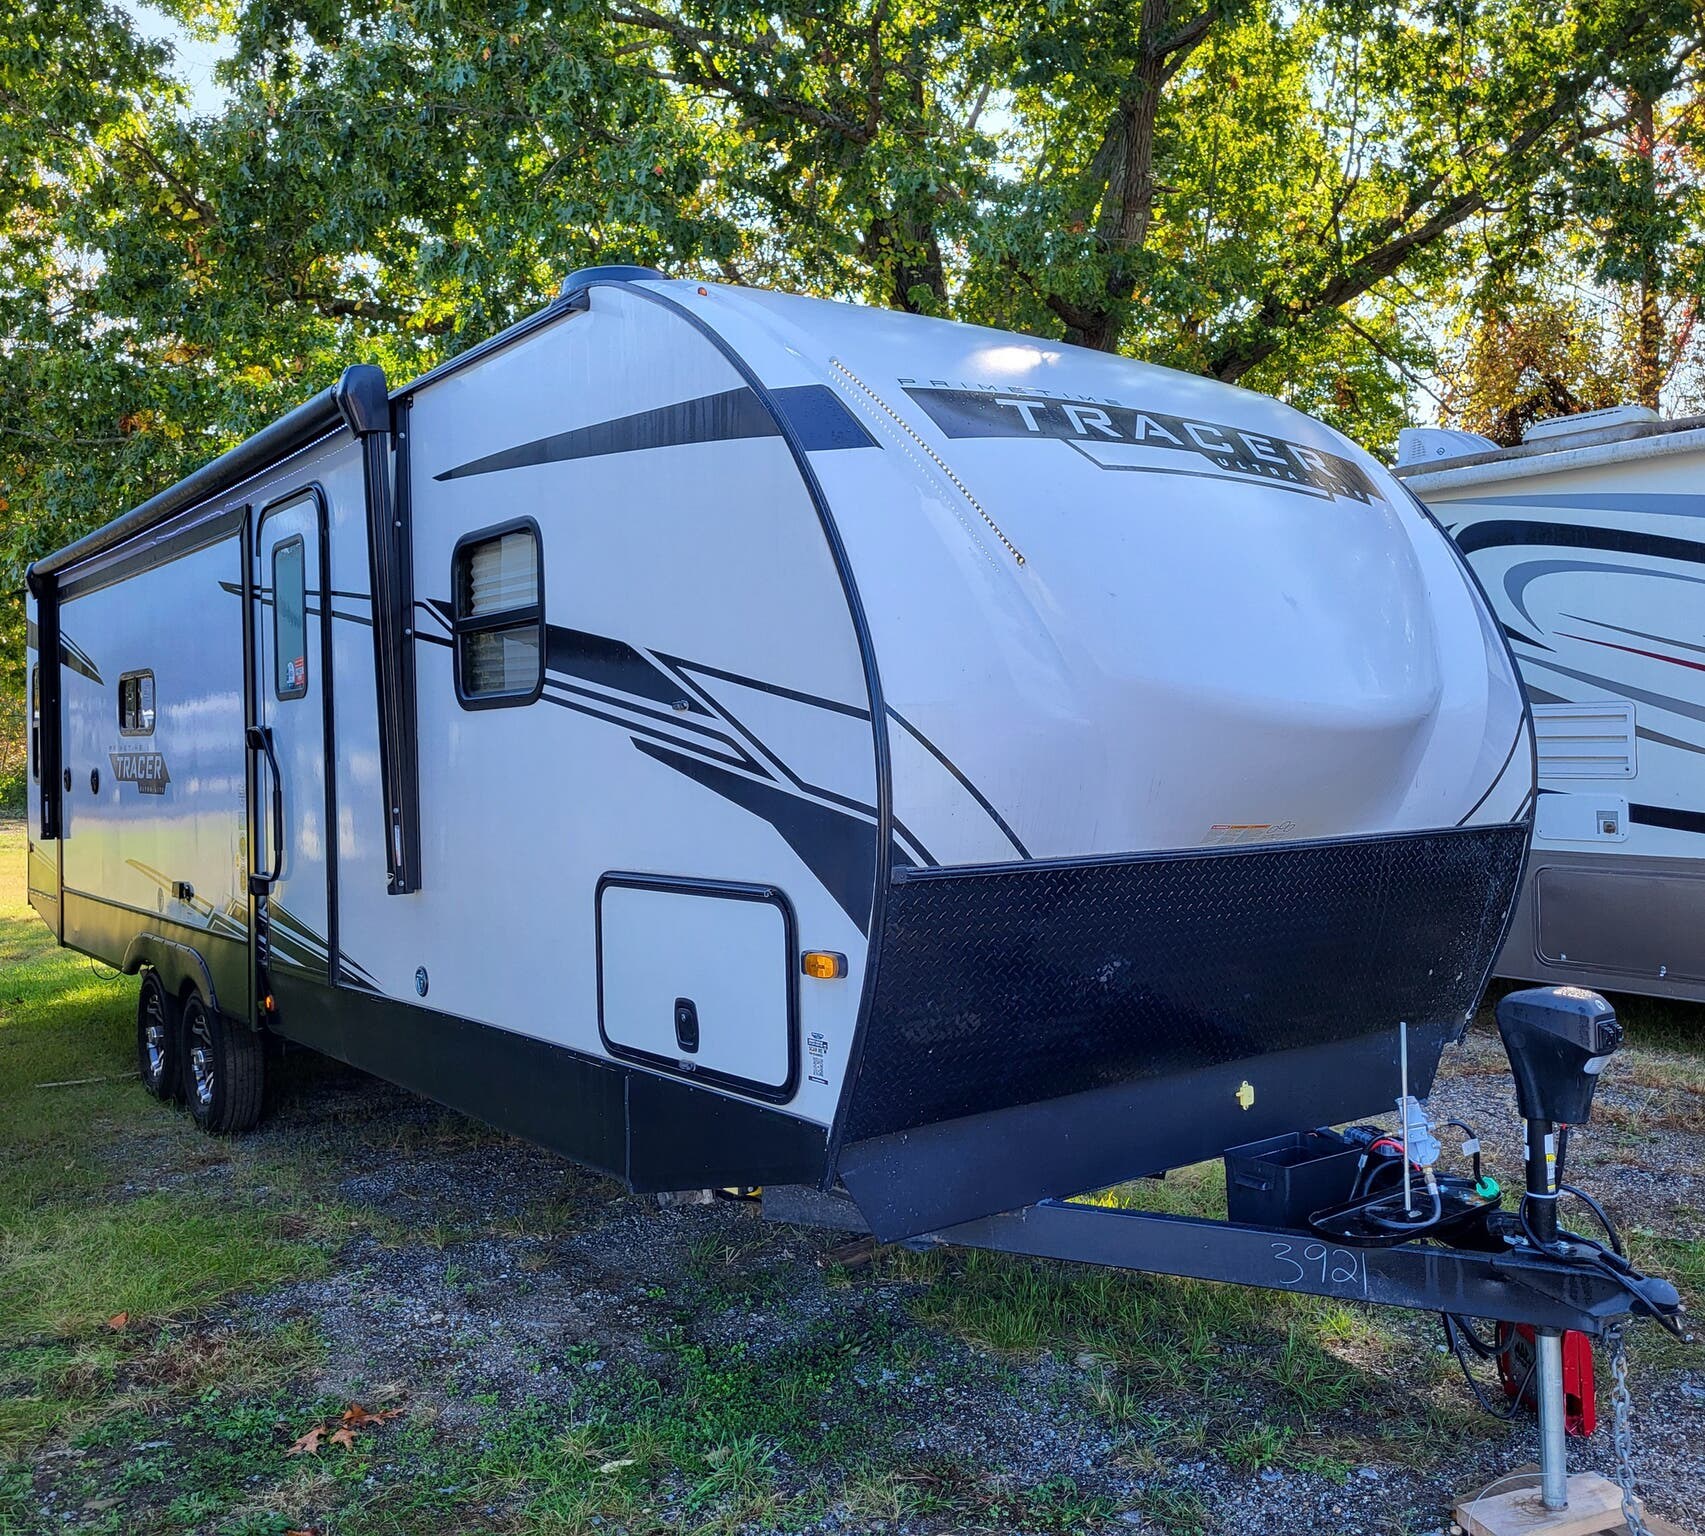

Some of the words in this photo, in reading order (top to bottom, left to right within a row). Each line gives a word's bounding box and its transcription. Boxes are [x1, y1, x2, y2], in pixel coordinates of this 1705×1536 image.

[995, 398, 1338, 479] TRACER
[1216, 457, 1365, 500] ULTRA-LITE
[116, 755, 162, 779] TRACER
[1271, 1242, 1368, 1296] 3921
